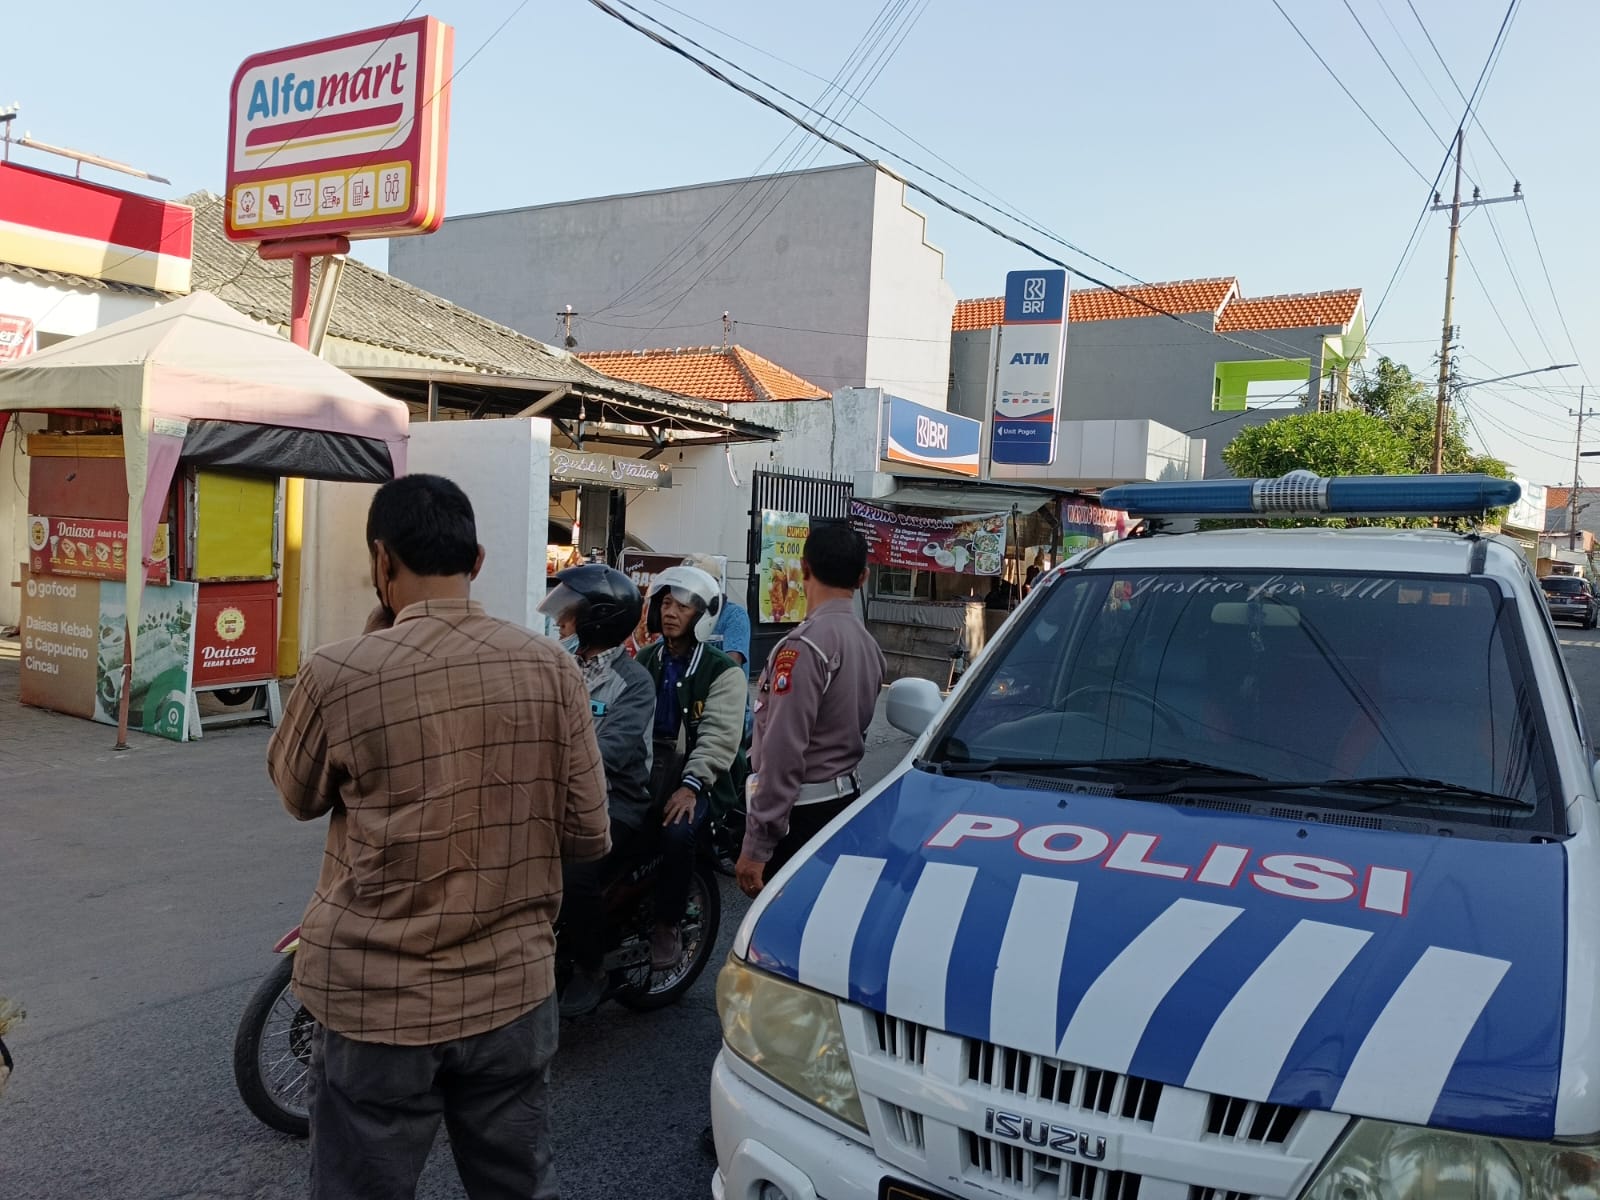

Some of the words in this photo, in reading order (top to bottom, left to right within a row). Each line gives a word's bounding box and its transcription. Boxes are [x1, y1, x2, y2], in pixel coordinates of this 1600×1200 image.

[247, 53, 407, 121] Alfamart
[1022, 301, 1045, 313] BRI
[1009, 352, 1050, 365] ATM
[929, 420, 949, 450] BRI
[610, 462, 659, 480] Station
[57, 521, 95, 539] Daiasa
[780, 543, 800, 555] 5.000
[38, 582, 77, 598] gofood
[1131, 575, 1243, 600] Justice
[1247, 574, 1306, 601] for
[1316, 578, 1397, 600] All
[26, 615, 58, 633] Daiasa
[60, 621, 93, 639] Kebab
[25, 636, 33, 649] &
[34, 638, 88, 659] Cappucino
[201, 645, 257, 660] Daiasa
[25, 655, 59, 675] Cincau
[202, 659, 224, 668] KEBAB
[924, 813, 1412, 917] POLISI
[984, 1107, 1107, 1162] ISUZU
